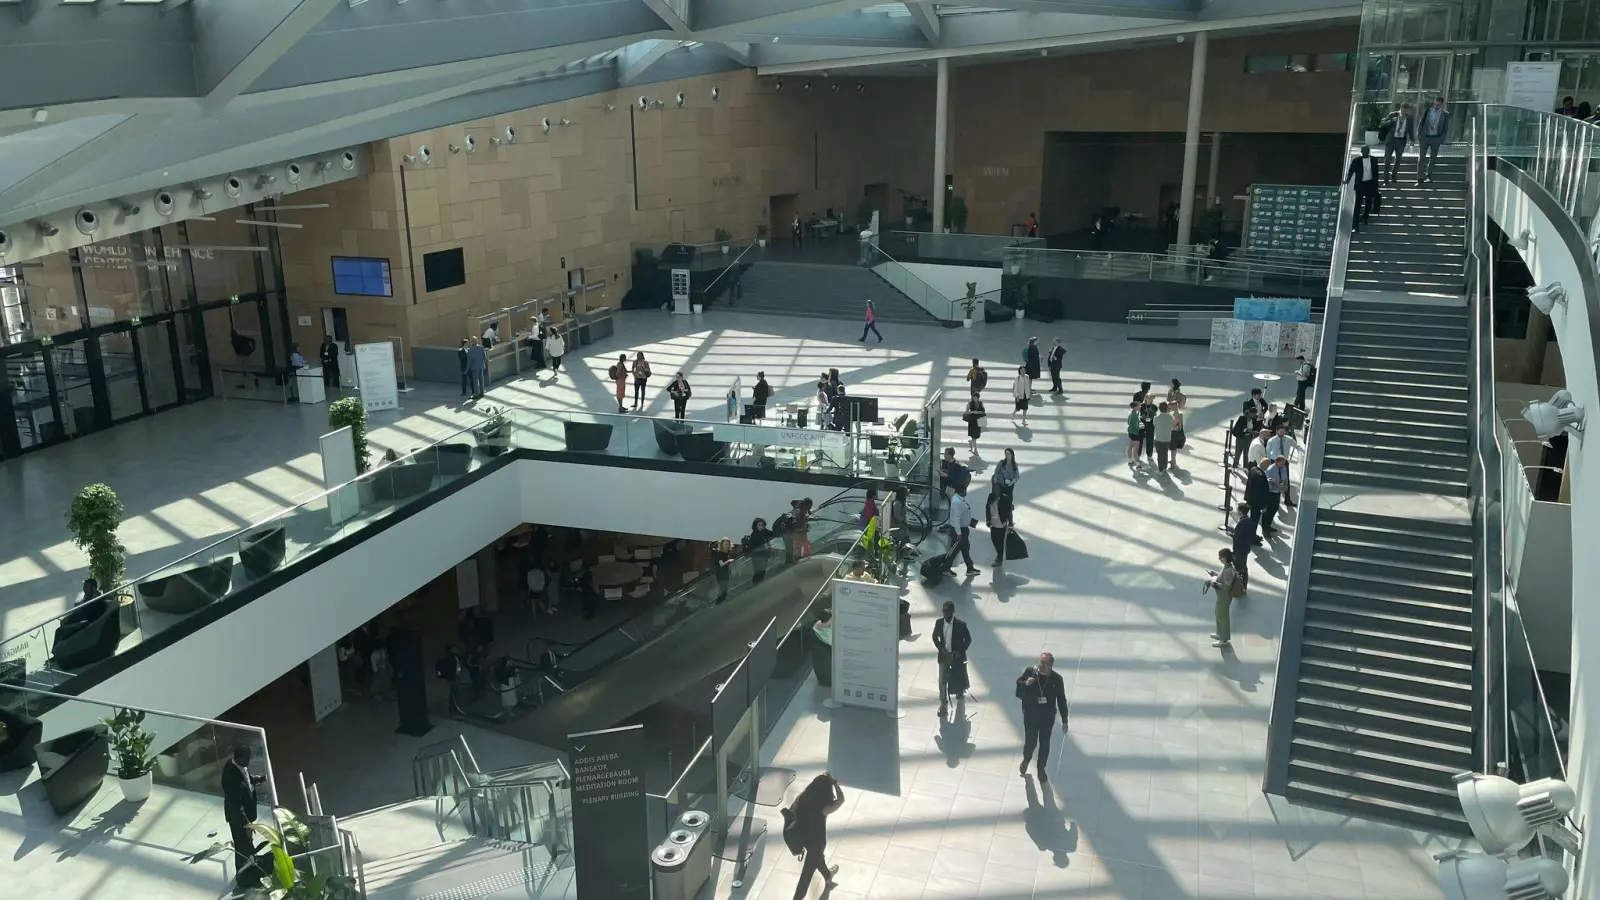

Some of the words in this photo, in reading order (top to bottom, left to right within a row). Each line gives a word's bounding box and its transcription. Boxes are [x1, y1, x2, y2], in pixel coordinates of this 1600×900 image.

[983, 166, 1009, 178] WIEN
[83, 245, 127, 257] WORLD
[780, 431, 809, 441] UNFCCC
[574, 756, 595, 765] ADDIS
[596, 752, 619, 762] ABEBA
[575, 764, 608, 774] BANGKOK
[576, 782, 616, 792] MEDITATION
[618, 776, 639, 786] ROOM
[582, 795, 609, 804] PLENARY
[610, 790, 640, 800] BUILDING
